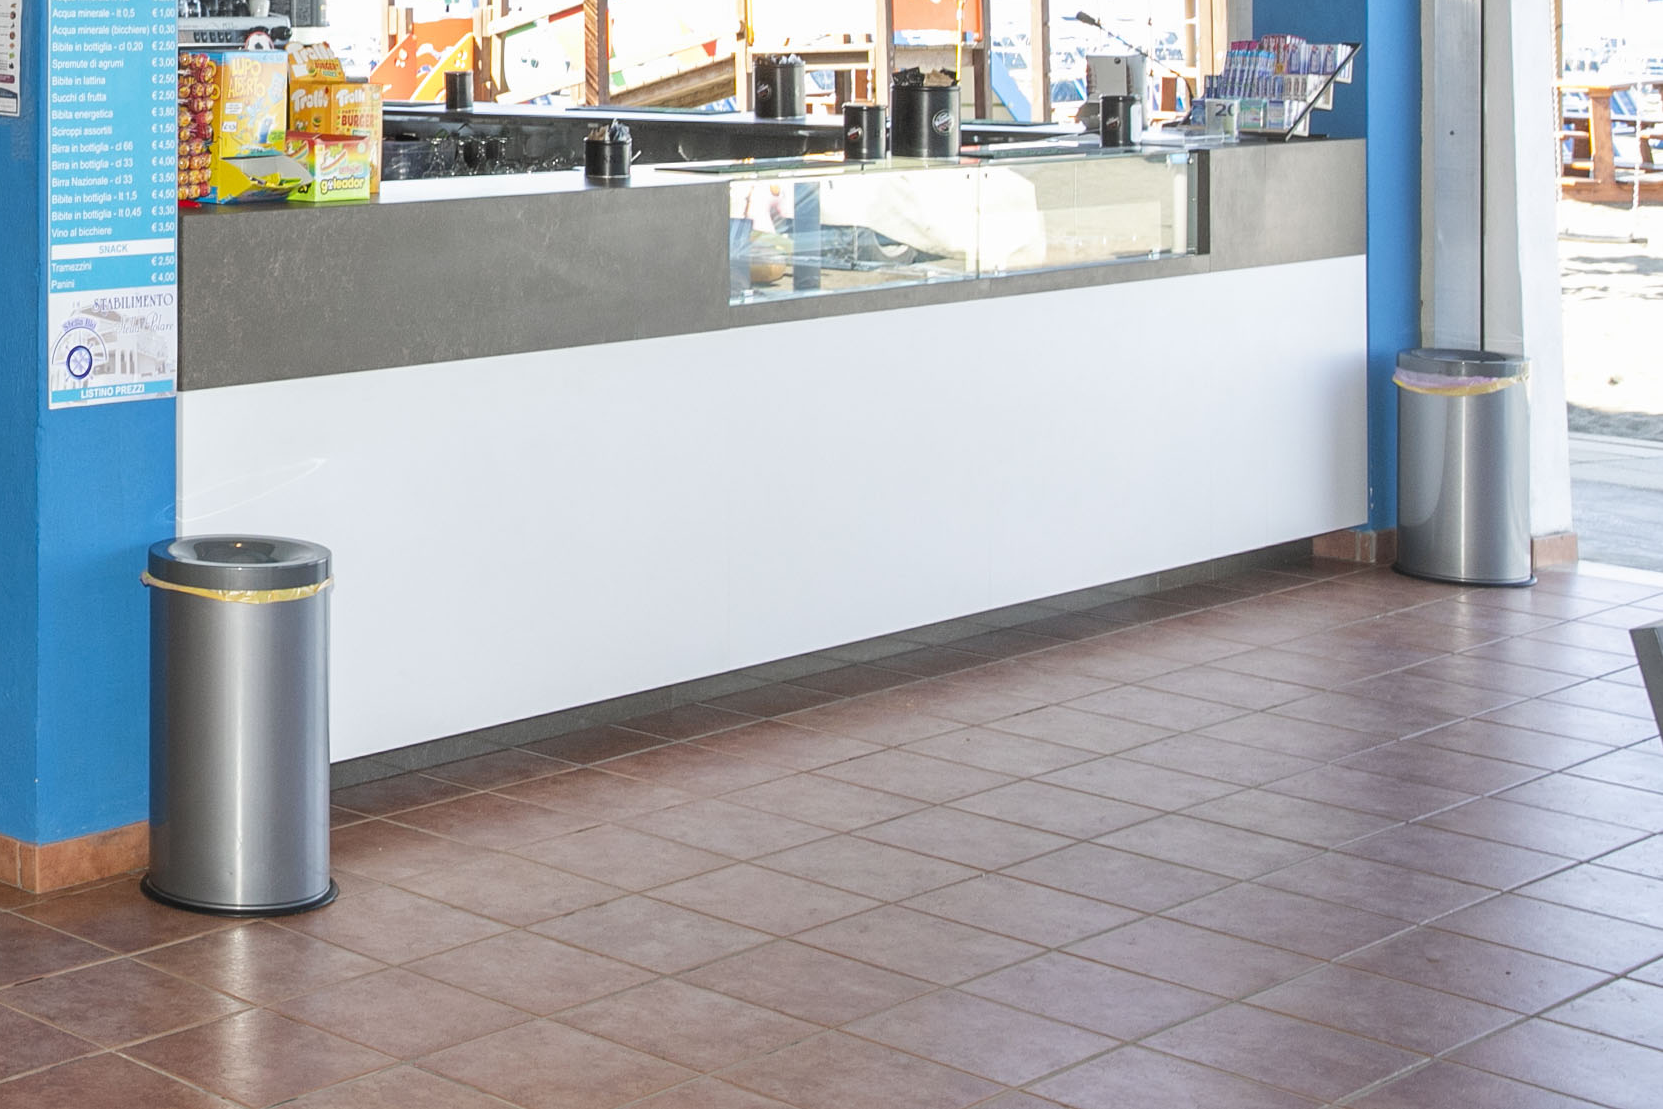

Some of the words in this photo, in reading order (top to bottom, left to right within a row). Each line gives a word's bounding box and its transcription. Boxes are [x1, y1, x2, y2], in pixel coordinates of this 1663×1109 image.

[52, 8, 76, 19] Acqua
[77, 9, 109, 17] minerale
[52, 25, 76, 36] Acqua
[77, 25, 109, 34] minerale
[52, 41, 73, 51] Bibite
[83, 42, 112, 53] bottiglia
[126, 41, 143, 51] 0,20
[52, 58, 88, 70] Spremute
[98, 59, 123, 70] agrumi
[232, 57, 262, 77] LUPO
[52, 76, 72, 85] Bibite
[83, 76, 105, 84] lattina
[51, 92, 76, 102] Succhi
[336, 88, 365, 108] Trolli
[341, 114, 375, 127] BURGER
[51, 143, 69, 153] Birra
[79, 142, 108, 154] bottiglia
[51, 160, 69, 170] Birra
[79, 159, 108, 170] bottiglia
[51, 177, 69, 187] Birra
[71, 176, 108, 186] Nazionale
[51, 194, 72, 204] Bibite
[82, 192, 111, 204] bottiglia
[51, 211, 72, 221] Bibite
[82, 209, 111, 220] bottiglia
[125, 206, 141, 217] 0,45
[51, 228, 68, 237] Vino
[78, 226, 111, 236] bicchiere
[99, 244, 127, 253] SNACK
[51, 261, 91, 272] Tramezzini
[51, 279, 74, 289] Panini
[94, 293, 174, 311] STABILIMENTO
[81, 385, 114, 399] LISTINO
[115, 382, 145, 398] PREZZI
